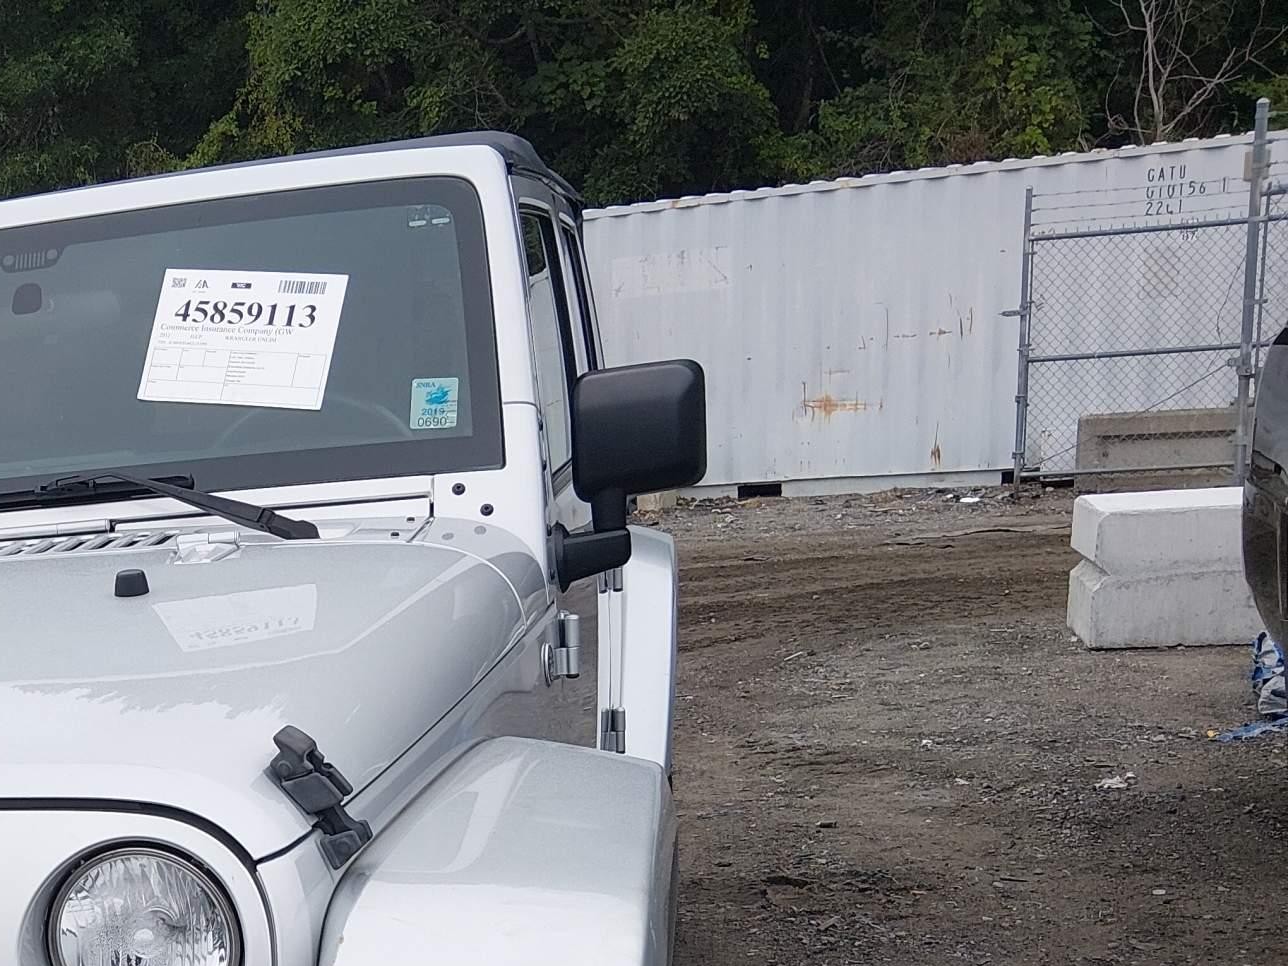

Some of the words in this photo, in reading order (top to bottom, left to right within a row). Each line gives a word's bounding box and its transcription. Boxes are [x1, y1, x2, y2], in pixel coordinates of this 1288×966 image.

[1147, 164, 1187, 182] GATU
[174, 299, 317, 329] 45859113
[201, 325, 236, 334] Insurance
[237, 326, 273, 336] Company
[418, 417, 447, 427] 0690
